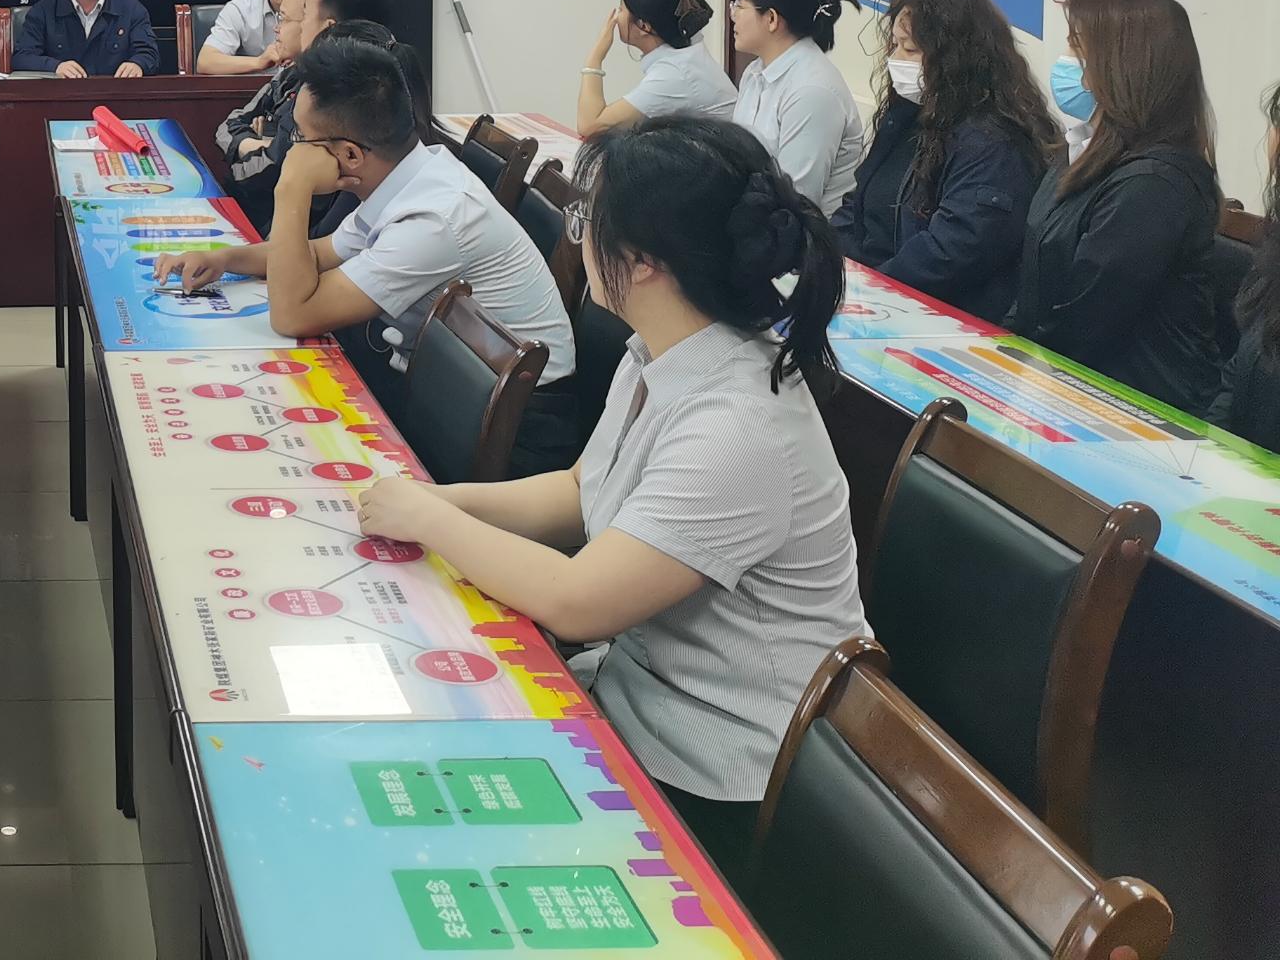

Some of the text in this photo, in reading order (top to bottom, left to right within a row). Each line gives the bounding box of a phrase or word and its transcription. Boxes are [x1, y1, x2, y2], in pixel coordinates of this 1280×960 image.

[374, 768, 419, 816] 发展理念
[467, 774, 502, 809] 绿色开采
[421, 879, 473, 937] 安全理念
[569, 886, 613, 928] 生命至上
[591, 885, 636, 928] 安全为天
